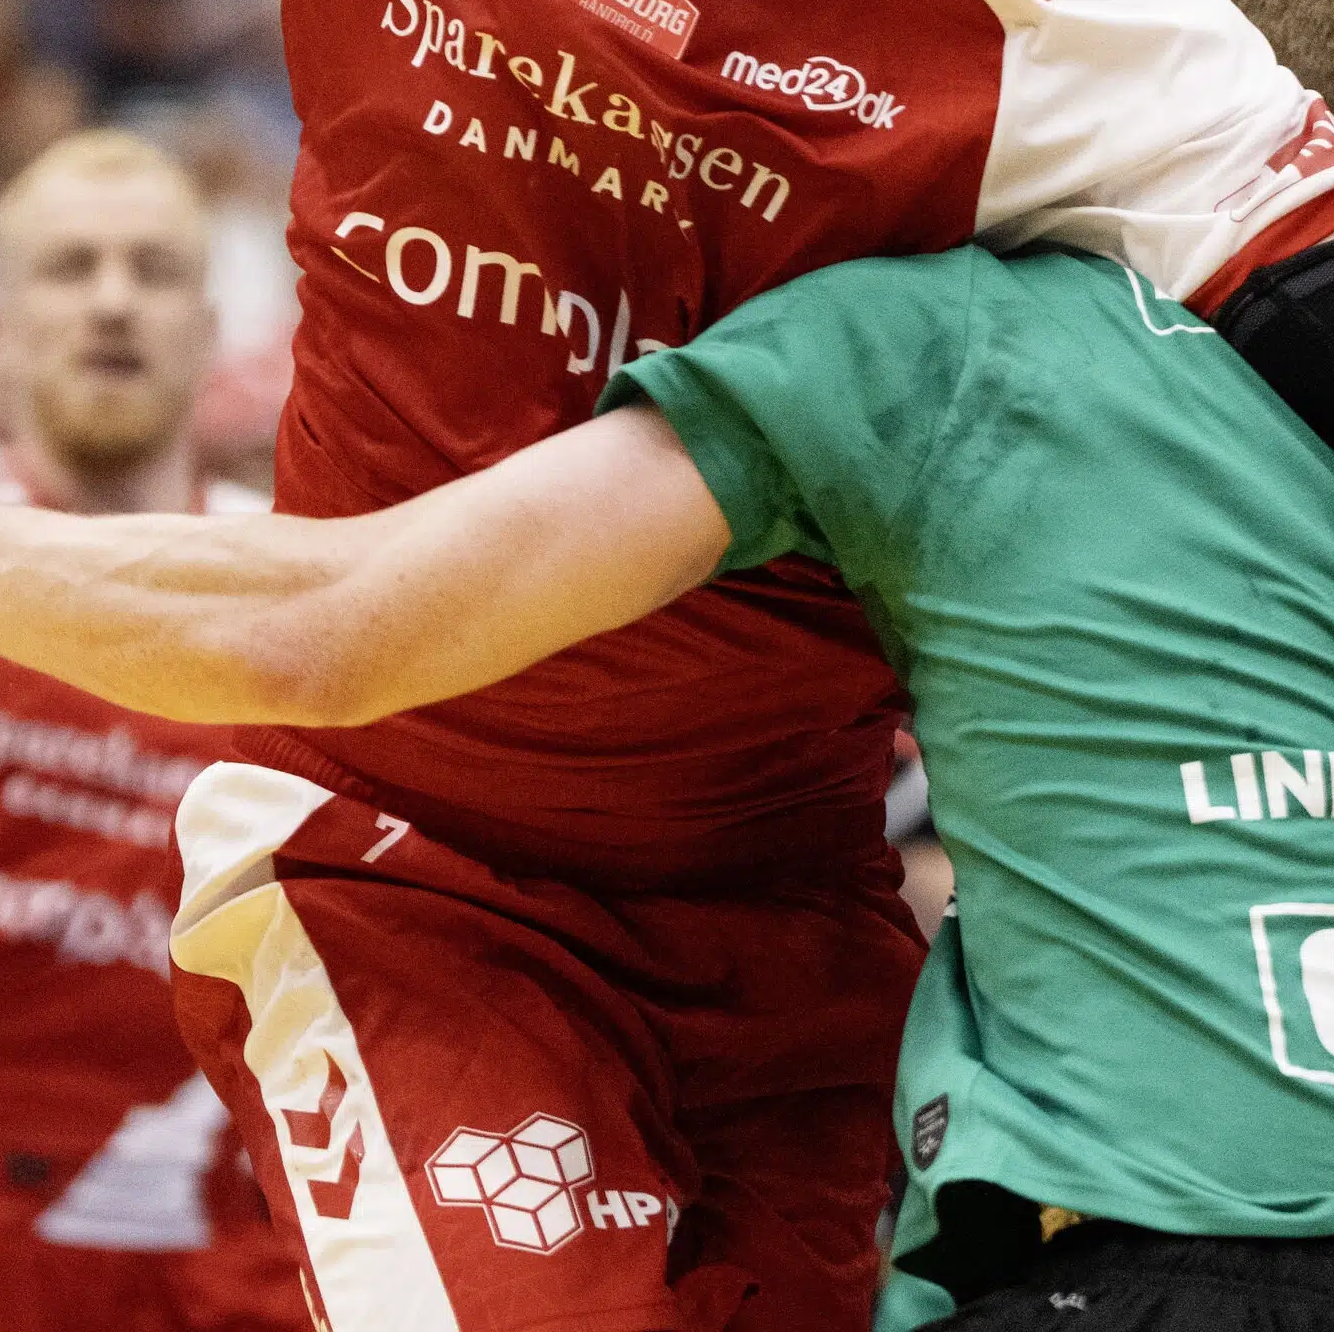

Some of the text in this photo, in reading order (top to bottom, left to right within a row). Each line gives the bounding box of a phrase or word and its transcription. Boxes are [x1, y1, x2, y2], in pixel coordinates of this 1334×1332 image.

[720, 51, 906, 129] med24.dk
[423, 100, 694, 230] DANMAR
[360, 813, 410, 863] 7
[586, 1190, 680, 1248] HP
